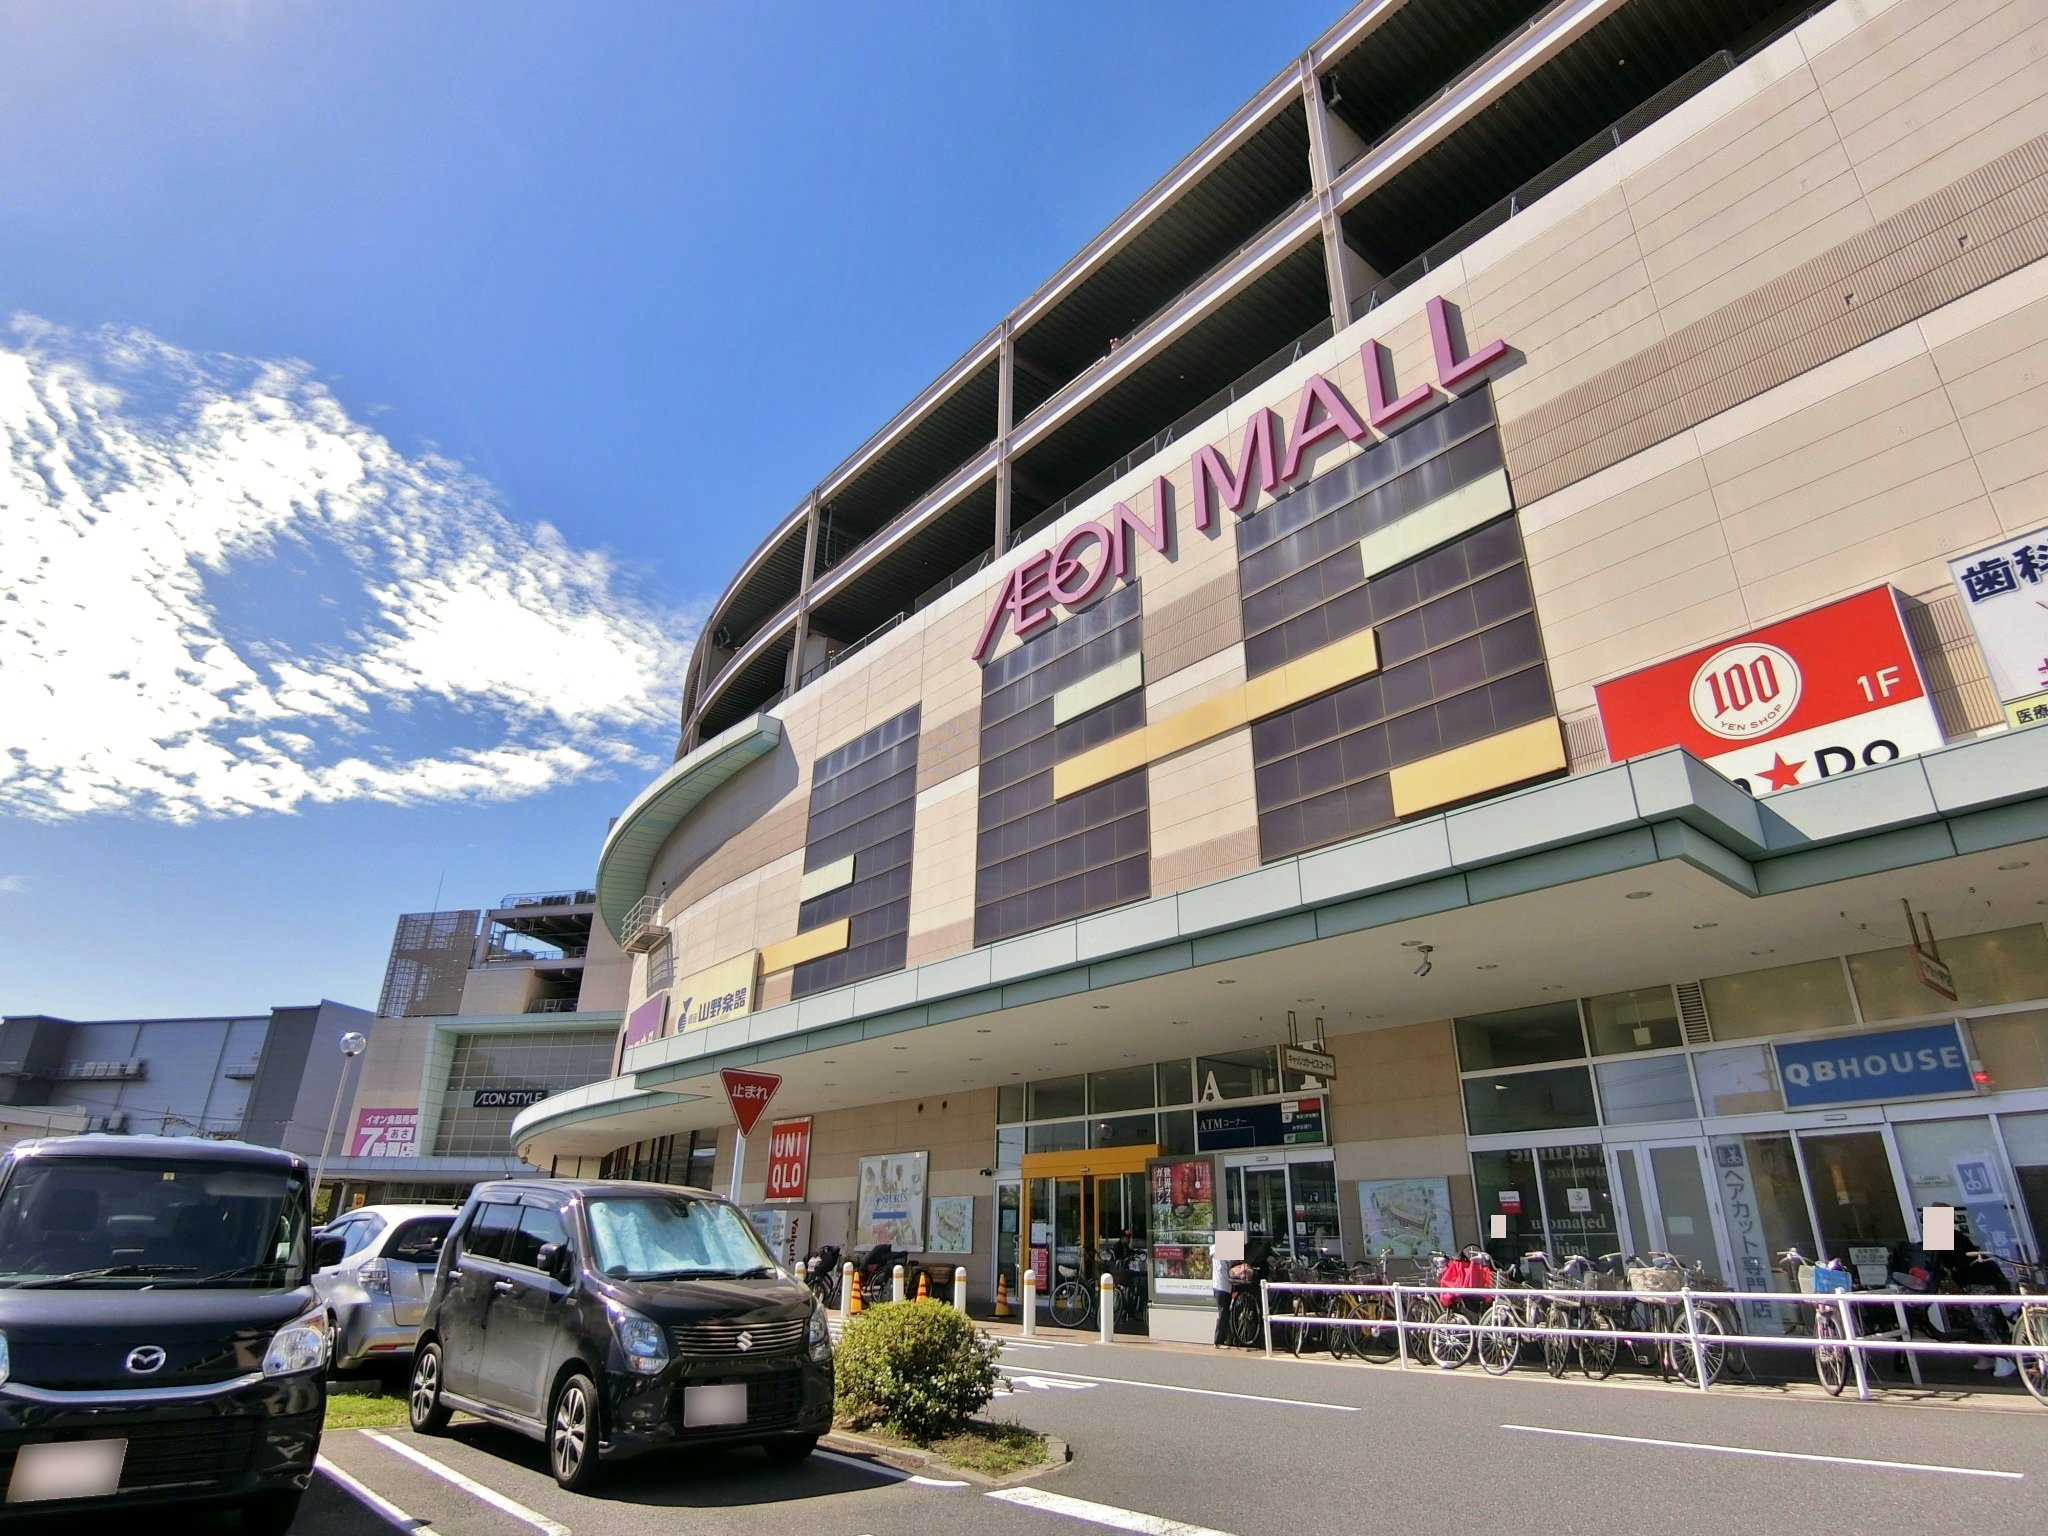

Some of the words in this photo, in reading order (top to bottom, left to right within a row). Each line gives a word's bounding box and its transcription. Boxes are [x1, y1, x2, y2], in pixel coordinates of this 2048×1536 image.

[1191, 295, 1508, 531] MALL
[1705, 654, 1779, 719] 100
[1856, 665, 1900, 703] 1F
[1720, 719, 1747, 732] YEN
[1750, 703, 1783, 730] SHOP
[508, 1092, 543, 1105] STYLE
[732, 1083, 768, 1100] 止まれ
[775, 1132, 802, 1158] UNI
[772, 1161, 801, 1193] QLO
[788, 1217, 799, 1266] Yakult
[1724, 1169, 1772, 1319] ヘアカット専門店
